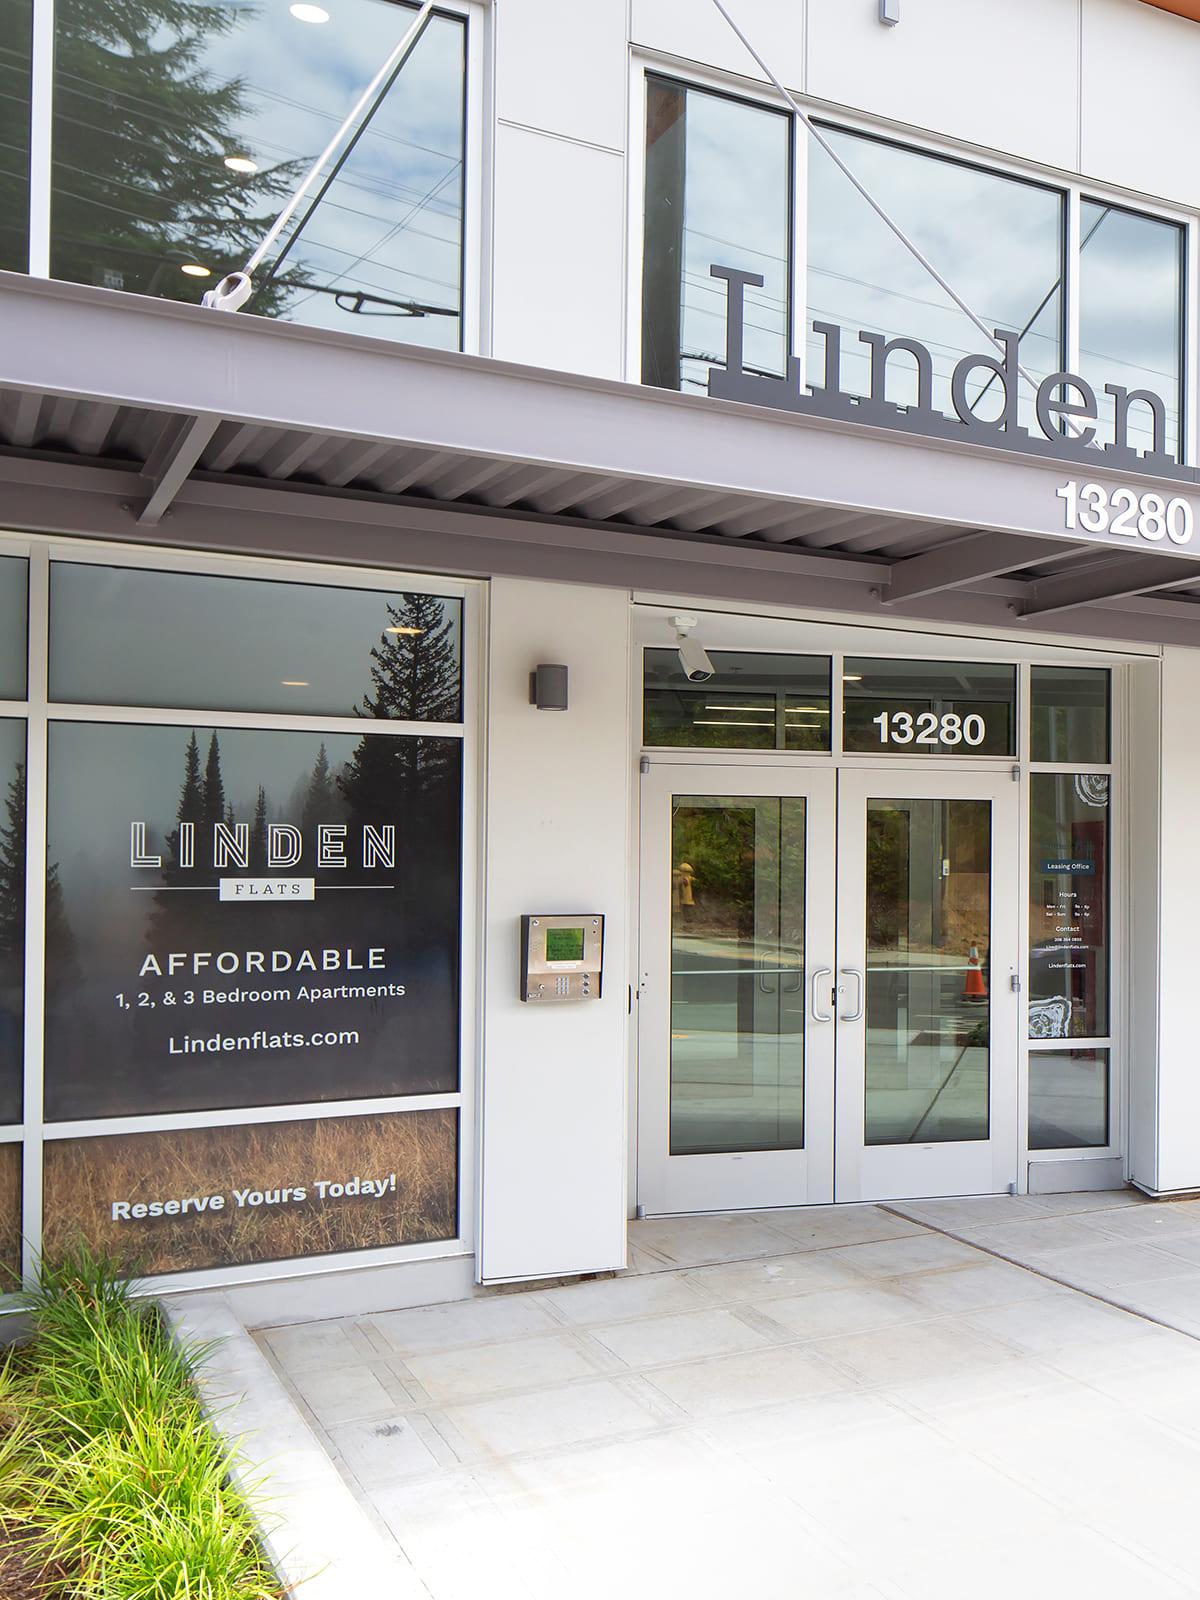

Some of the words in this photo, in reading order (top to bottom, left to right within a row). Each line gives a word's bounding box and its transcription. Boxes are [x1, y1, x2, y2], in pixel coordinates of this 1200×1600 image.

[708, 265, 1184, 465] Linden
[1055, 480, 1194, 545] 13280
[873, 712, 986, 746] 13280
[130, 822, 396, 868] LINDEN
[234, 884, 301, 895] FLATS
[138, 948, 386, 976] AFFORDABLE
[115, 993, 130, 1010] 1,
[137, 991, 156, 1009] 2,
[162, 990, 176, 1006] &
[183, 990, 195, 1005] 3
[203, 987, 290, 1004] Bedroom
[296, 982, 406, 1003] Apartments
[168, 1030, 360, 1054] Lindenflats.com
[111, 1194, 225, 1221] Reserve
[232, 1184, 307, 1208] Yours
[313, 1174, 397, 1199] Today!
